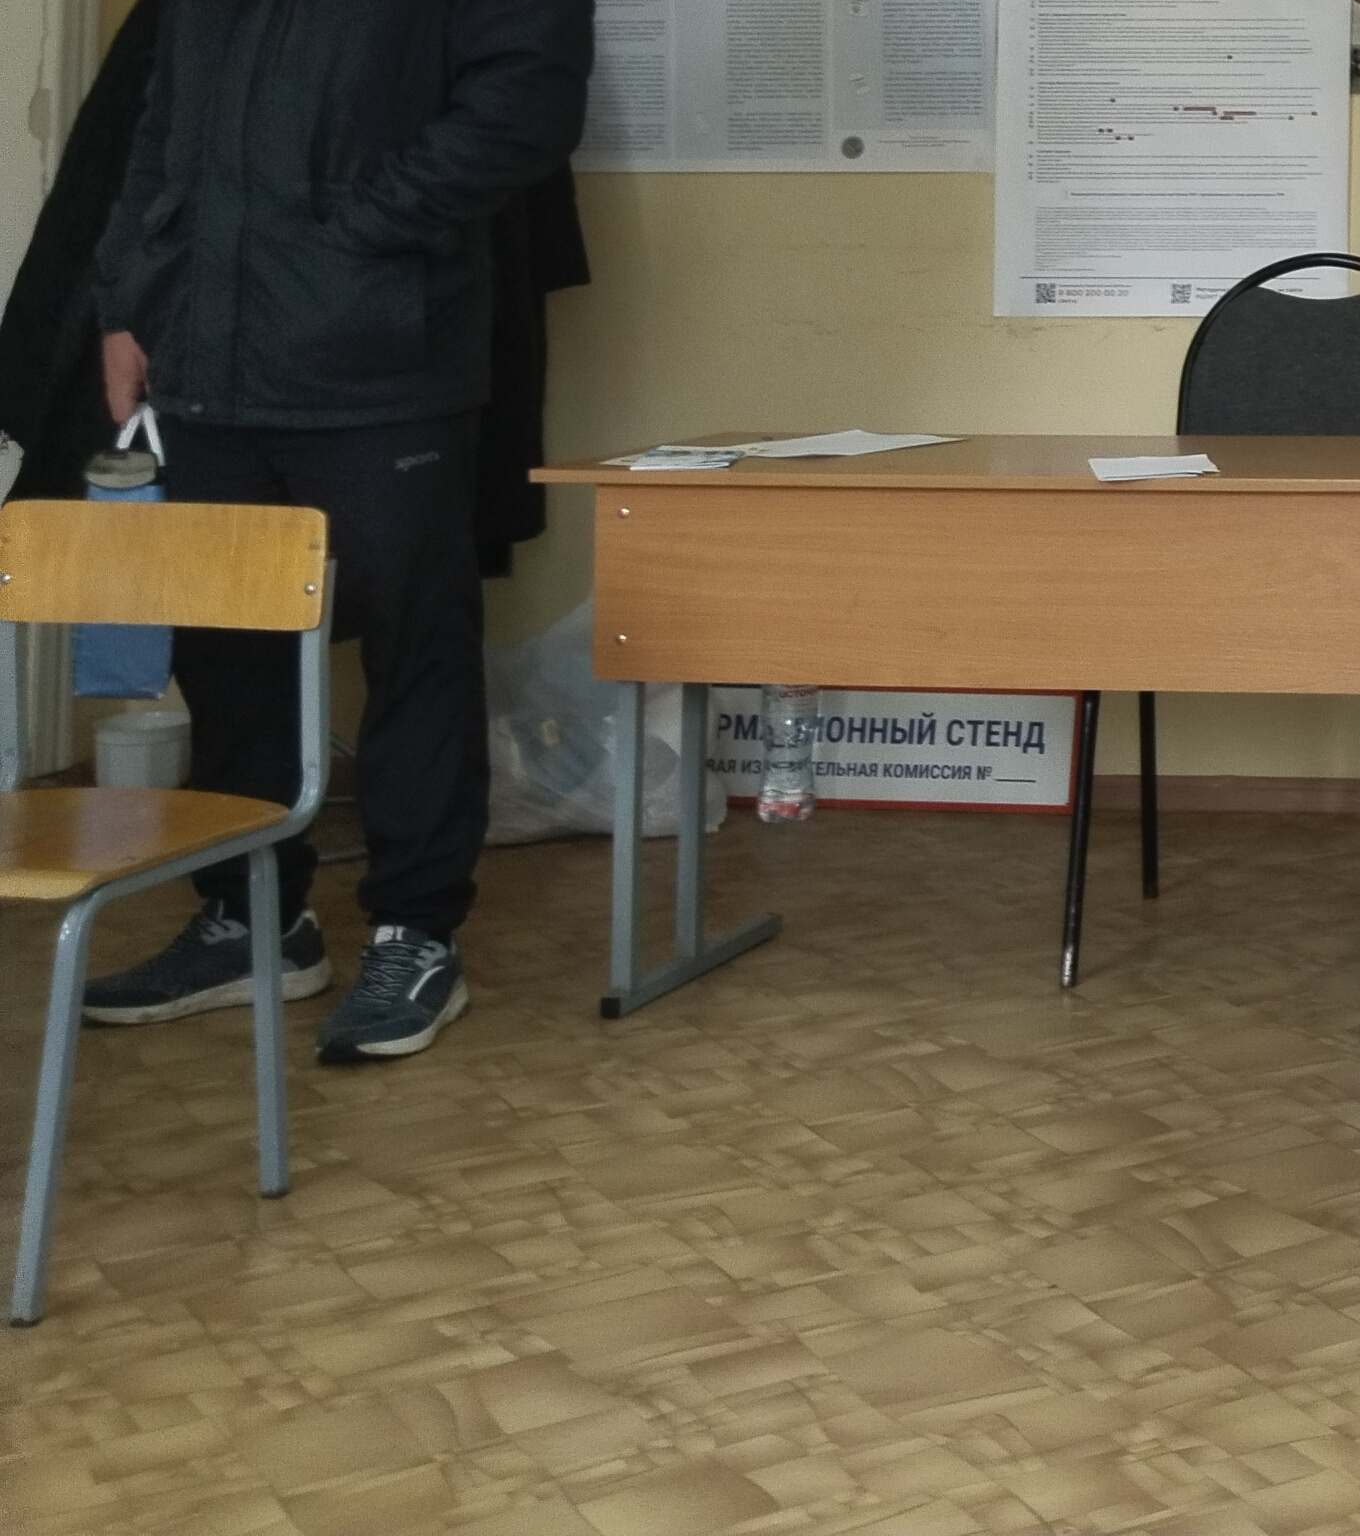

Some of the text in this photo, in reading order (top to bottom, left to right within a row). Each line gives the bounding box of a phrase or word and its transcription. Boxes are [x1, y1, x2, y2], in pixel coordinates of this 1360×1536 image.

[946, 719, 1046, 754] СТЕНД
[741, 762, 878, 778] ИЗЕЛЬНАЯ
[883, 763, 972, 781] КОМИССИЯ
